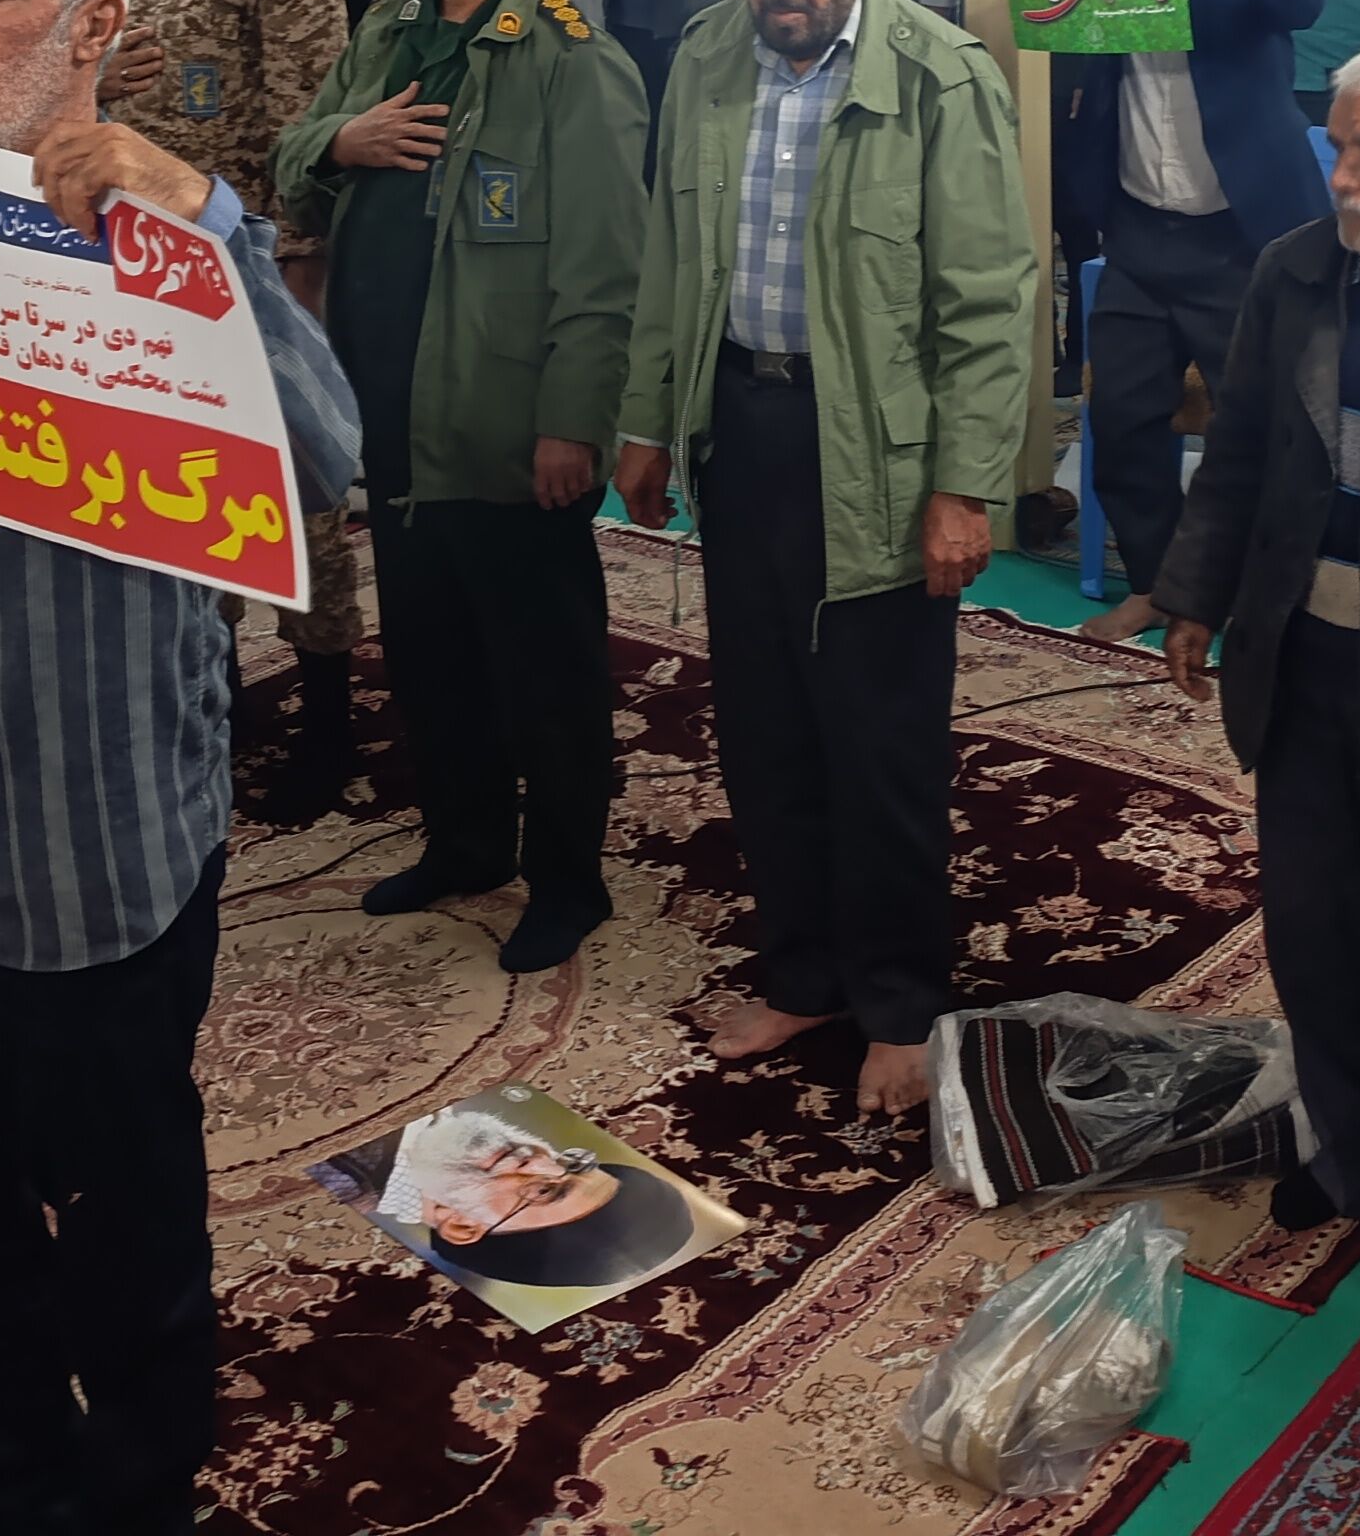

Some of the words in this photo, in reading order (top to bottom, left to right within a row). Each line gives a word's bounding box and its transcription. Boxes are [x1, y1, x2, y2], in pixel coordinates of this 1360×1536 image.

[113, 211, 165, 277] دی
[73, 320, 97, 344] در
[103, 327, 136, 351] دی
[143, 330, 174, 359] نهم
[16, 341, 64, 370] دهان
[70, 357, 89, 383] به
[95, 364, 172, 394] محکمی
[178, 380, 227, 408] مشت
[70, 449, 126, 531] بر
[139, 448, 284, 562] مرگ
